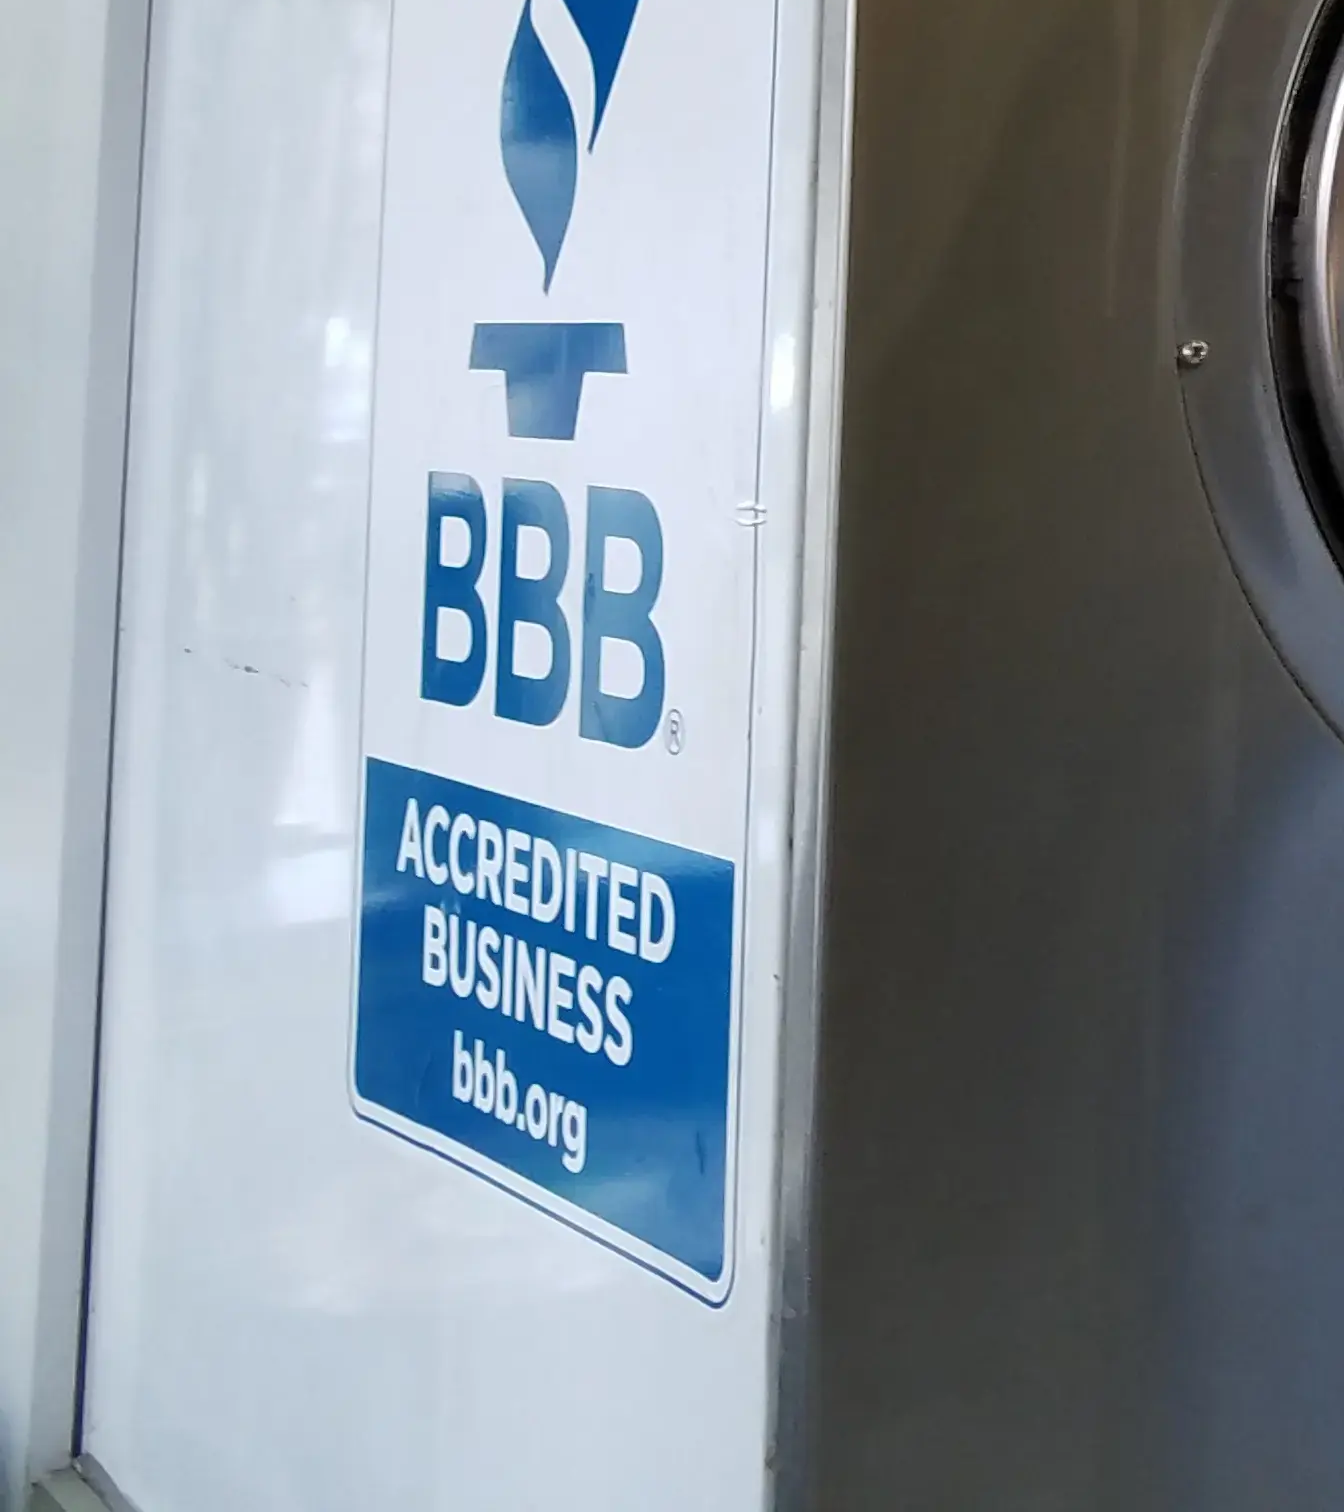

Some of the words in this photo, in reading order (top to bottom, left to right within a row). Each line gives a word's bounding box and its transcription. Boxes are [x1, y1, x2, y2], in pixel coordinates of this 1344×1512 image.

[420, 470, 666, 751] BBB
[396, 798, 676, 966] ACCREDITED
[421, 914, 634, 1067] BUSINESS
[451, 1031, 588, 1174] bbb.org
